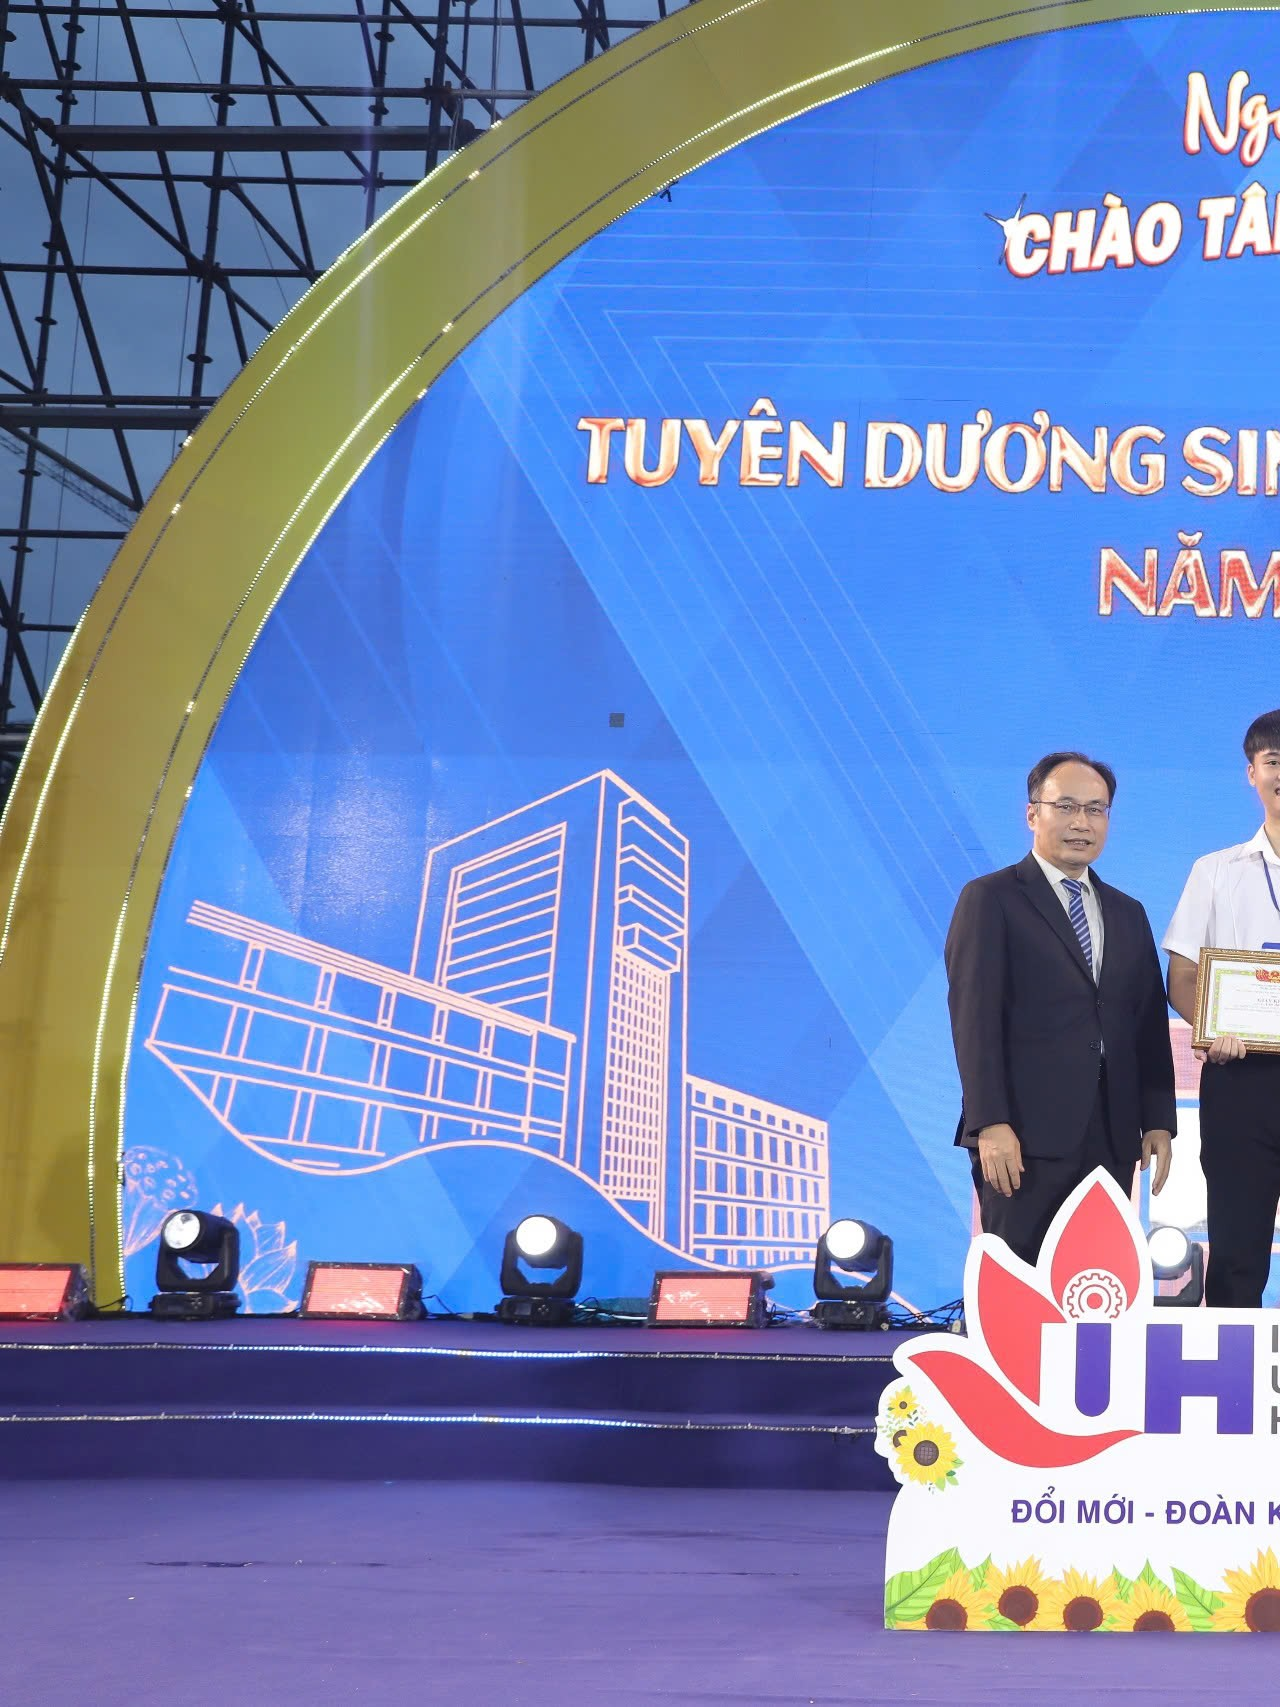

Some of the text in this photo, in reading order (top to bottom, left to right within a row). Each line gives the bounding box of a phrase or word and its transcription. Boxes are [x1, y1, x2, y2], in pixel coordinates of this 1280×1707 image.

[1004, 192, 1183, 278] CHÀO
[576, 397, 847, 489] TUYÊN
[863, 408, 1167, 497] DƯƠNG
[1010, 1486, 1065, 1524] ĐỔI
[1077, 1495, 1134, 1525] MỚI
[1165, 1495, 1255, 1525] ĐOÀN
